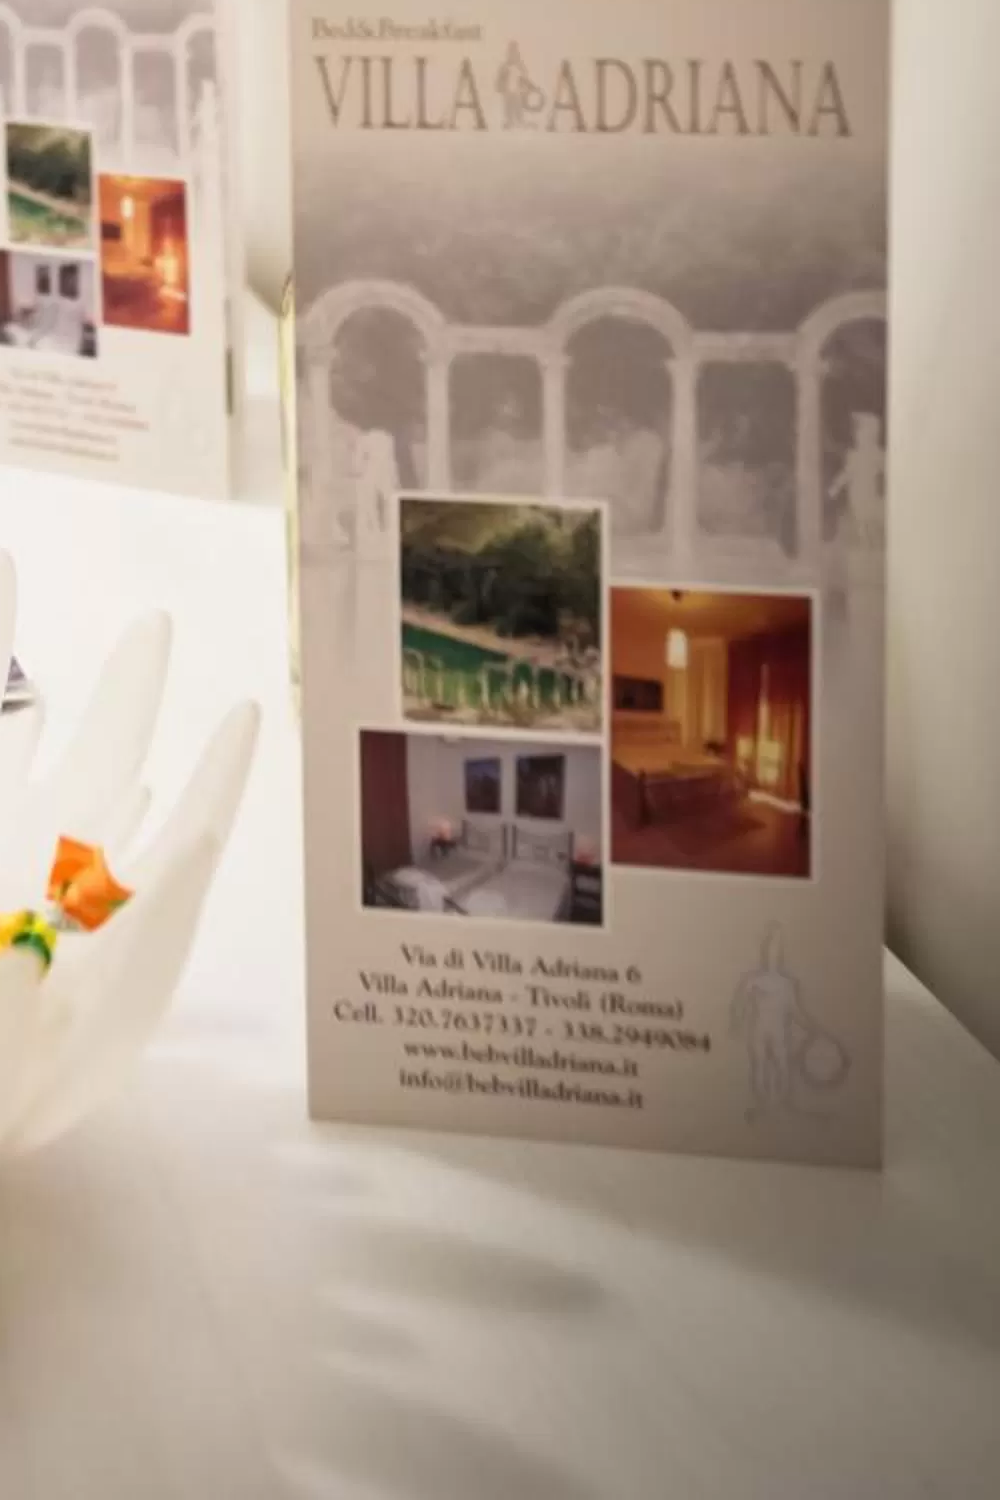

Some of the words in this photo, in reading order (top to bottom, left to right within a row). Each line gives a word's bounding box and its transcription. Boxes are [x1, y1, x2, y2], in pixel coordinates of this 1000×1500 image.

[313, 55, 489, 131] VILLA
[545, 58, 854, 137] ADRIANA
[400, 942, 437, 968] Via
[444, 948, 464, 970] di
[471, 949, 523, 976] Villa
[530, 956, 619, 983] Adriana
[625, 964, 642, 985] 6
[333, 1002, 384, 1025] Cell.
[358, 970, 409, 996] Villa
[416, 977, 504, 1003] Adriana
[524, 983, 592, 1012] Tivoli
[598, 991, 684, 1021] (Roma)
